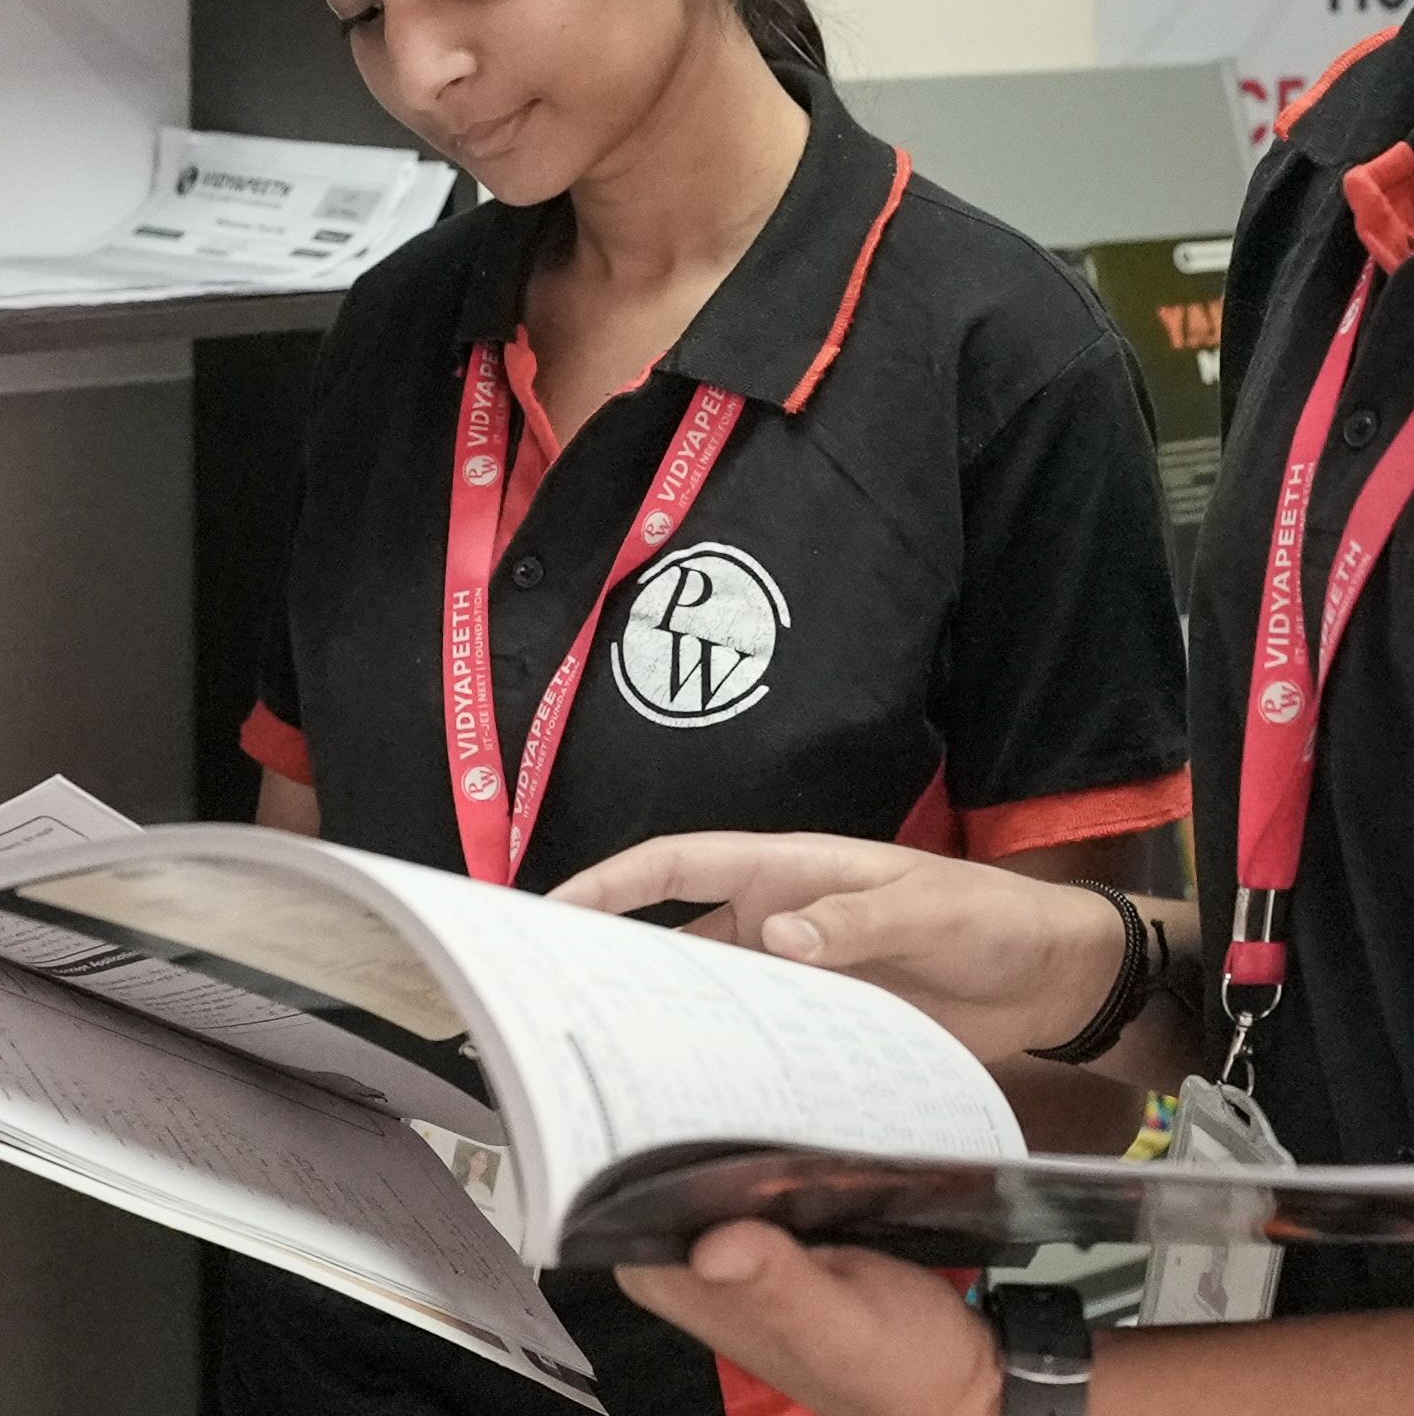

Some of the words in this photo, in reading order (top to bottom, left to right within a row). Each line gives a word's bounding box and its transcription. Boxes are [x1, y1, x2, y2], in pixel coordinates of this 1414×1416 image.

[474, 587, 485, 665] FOUNDATION
[1264, 463, 1305, 669] VIDYAPEETH
[453, 589, 479, 760] VIDYAPEETH
[514, 655, 577, 814] VIDYAPEETH
